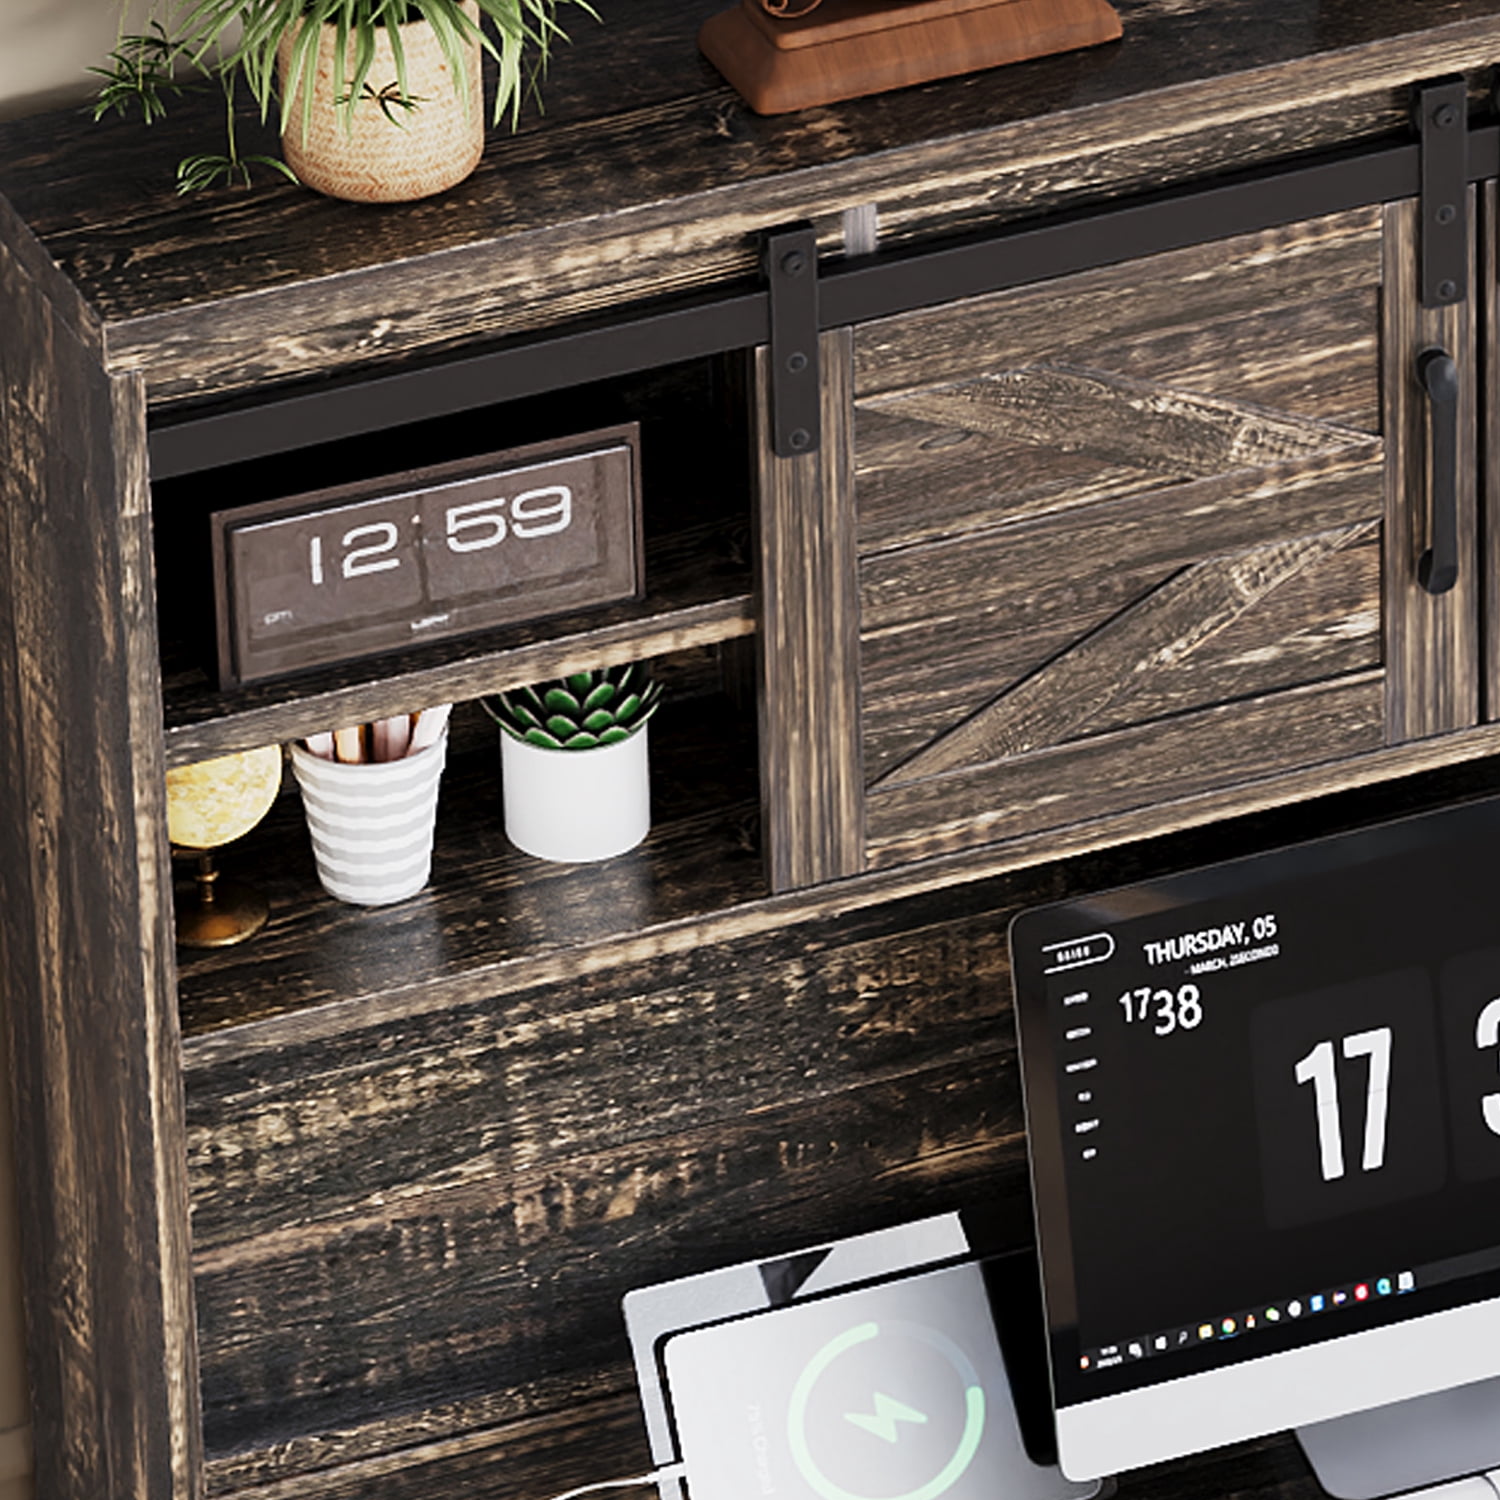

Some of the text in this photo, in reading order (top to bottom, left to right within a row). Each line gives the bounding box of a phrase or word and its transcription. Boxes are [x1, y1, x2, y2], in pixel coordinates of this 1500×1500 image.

[1143, 914, 1278, 966] THURSDAY, 05
[1295, 1027, 1392, 1181] 17
